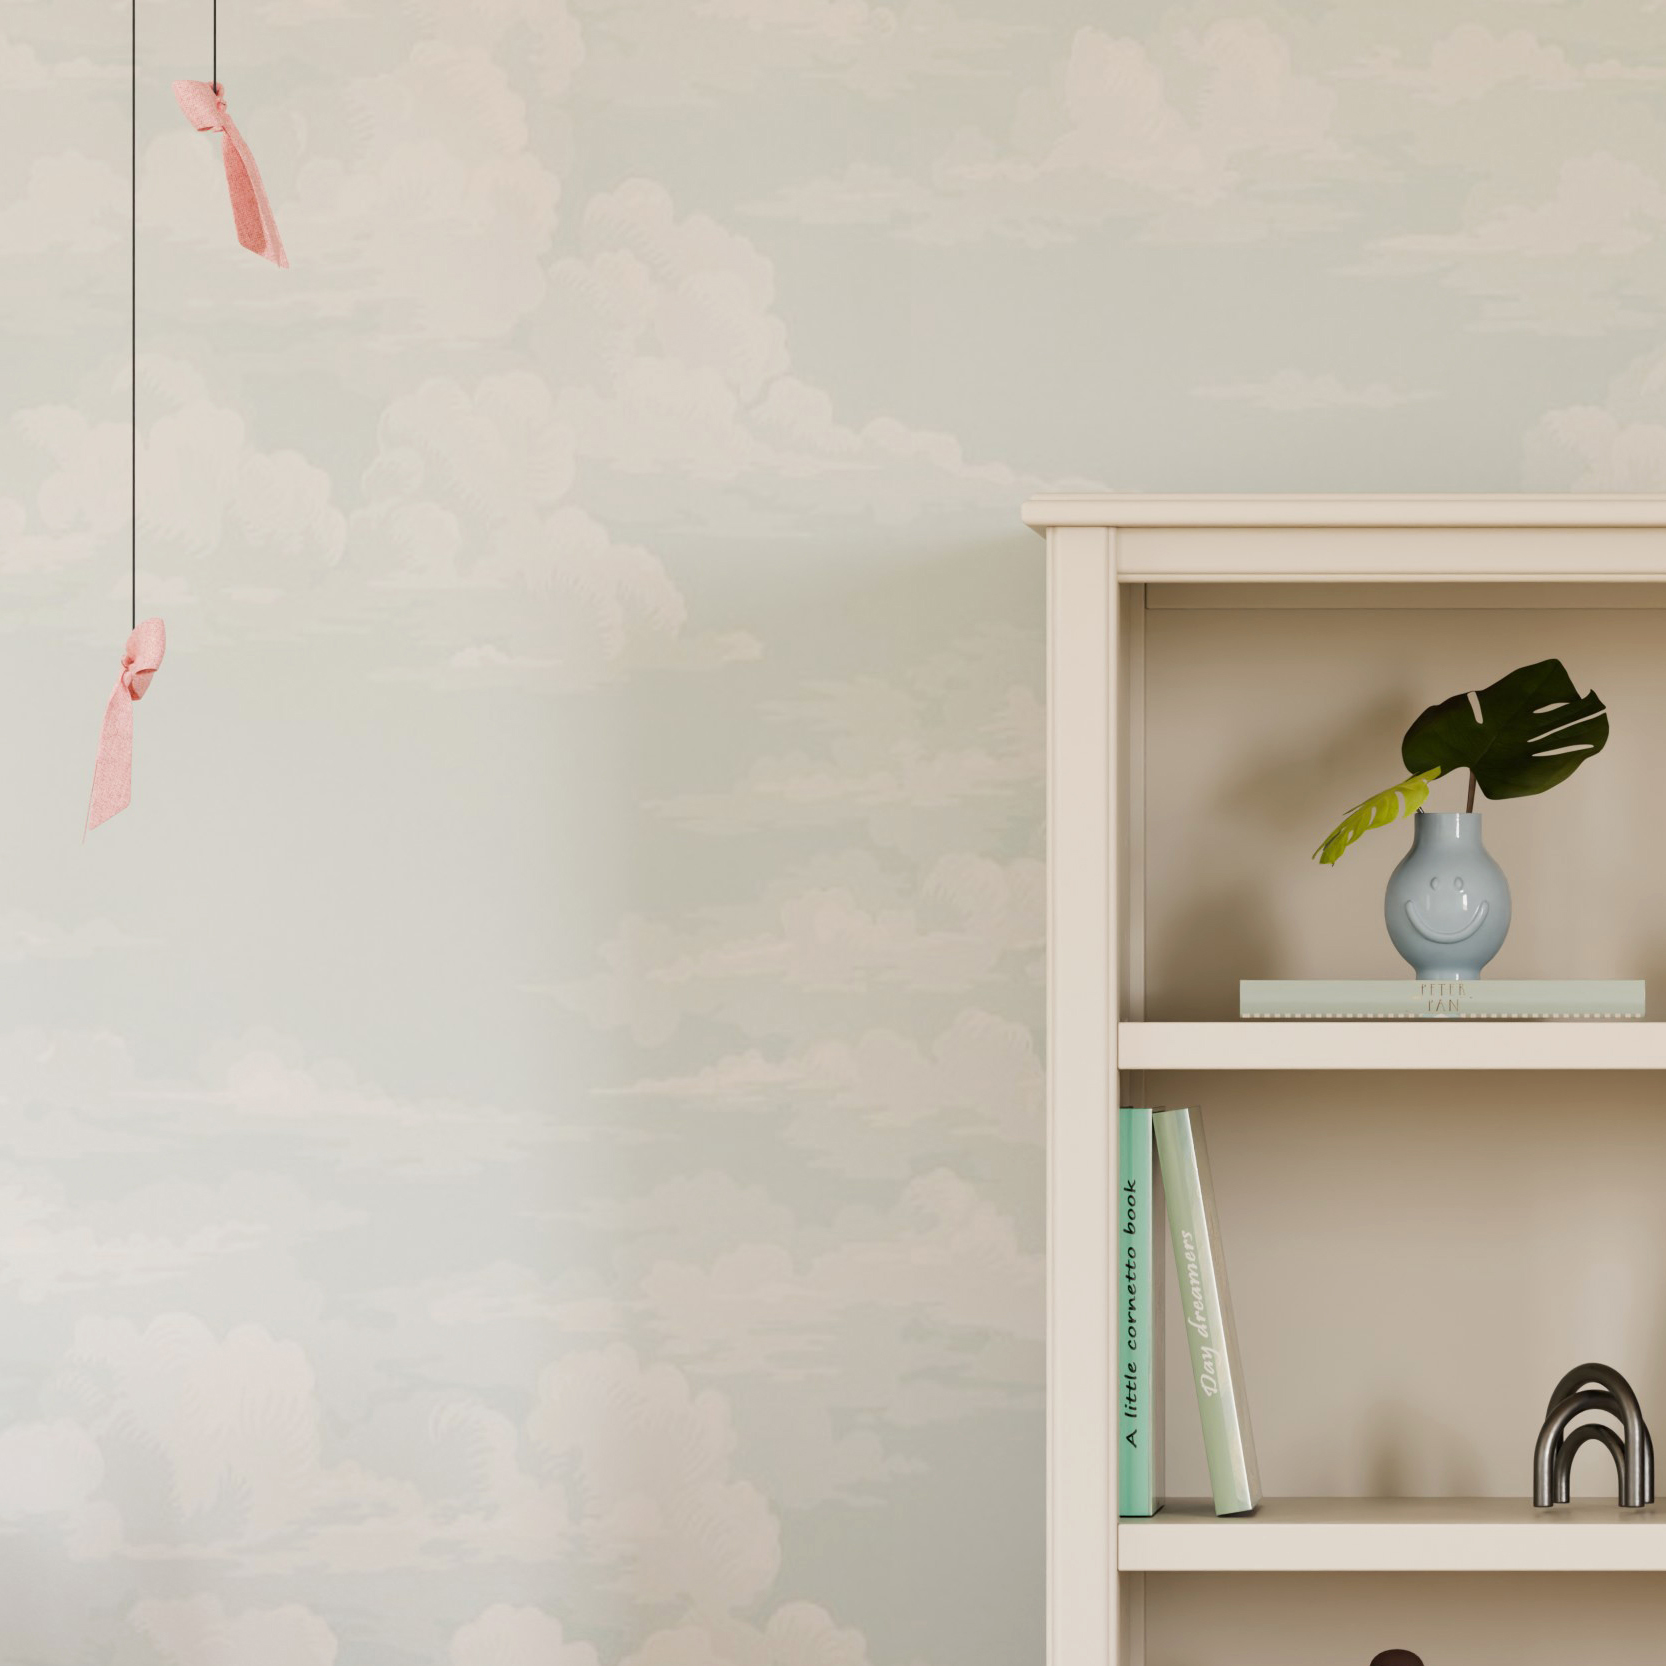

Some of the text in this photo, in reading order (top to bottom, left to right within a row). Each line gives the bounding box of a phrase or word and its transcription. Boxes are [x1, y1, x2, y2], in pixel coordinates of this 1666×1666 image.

[1421, 983, 1466, 996] PETER
[1428, 999, 1459, 1012] PAN
[1123, 1179, 1137, 1448] A little cornetto book
[1181, 1230, 1221, 1397] Day dreamers
